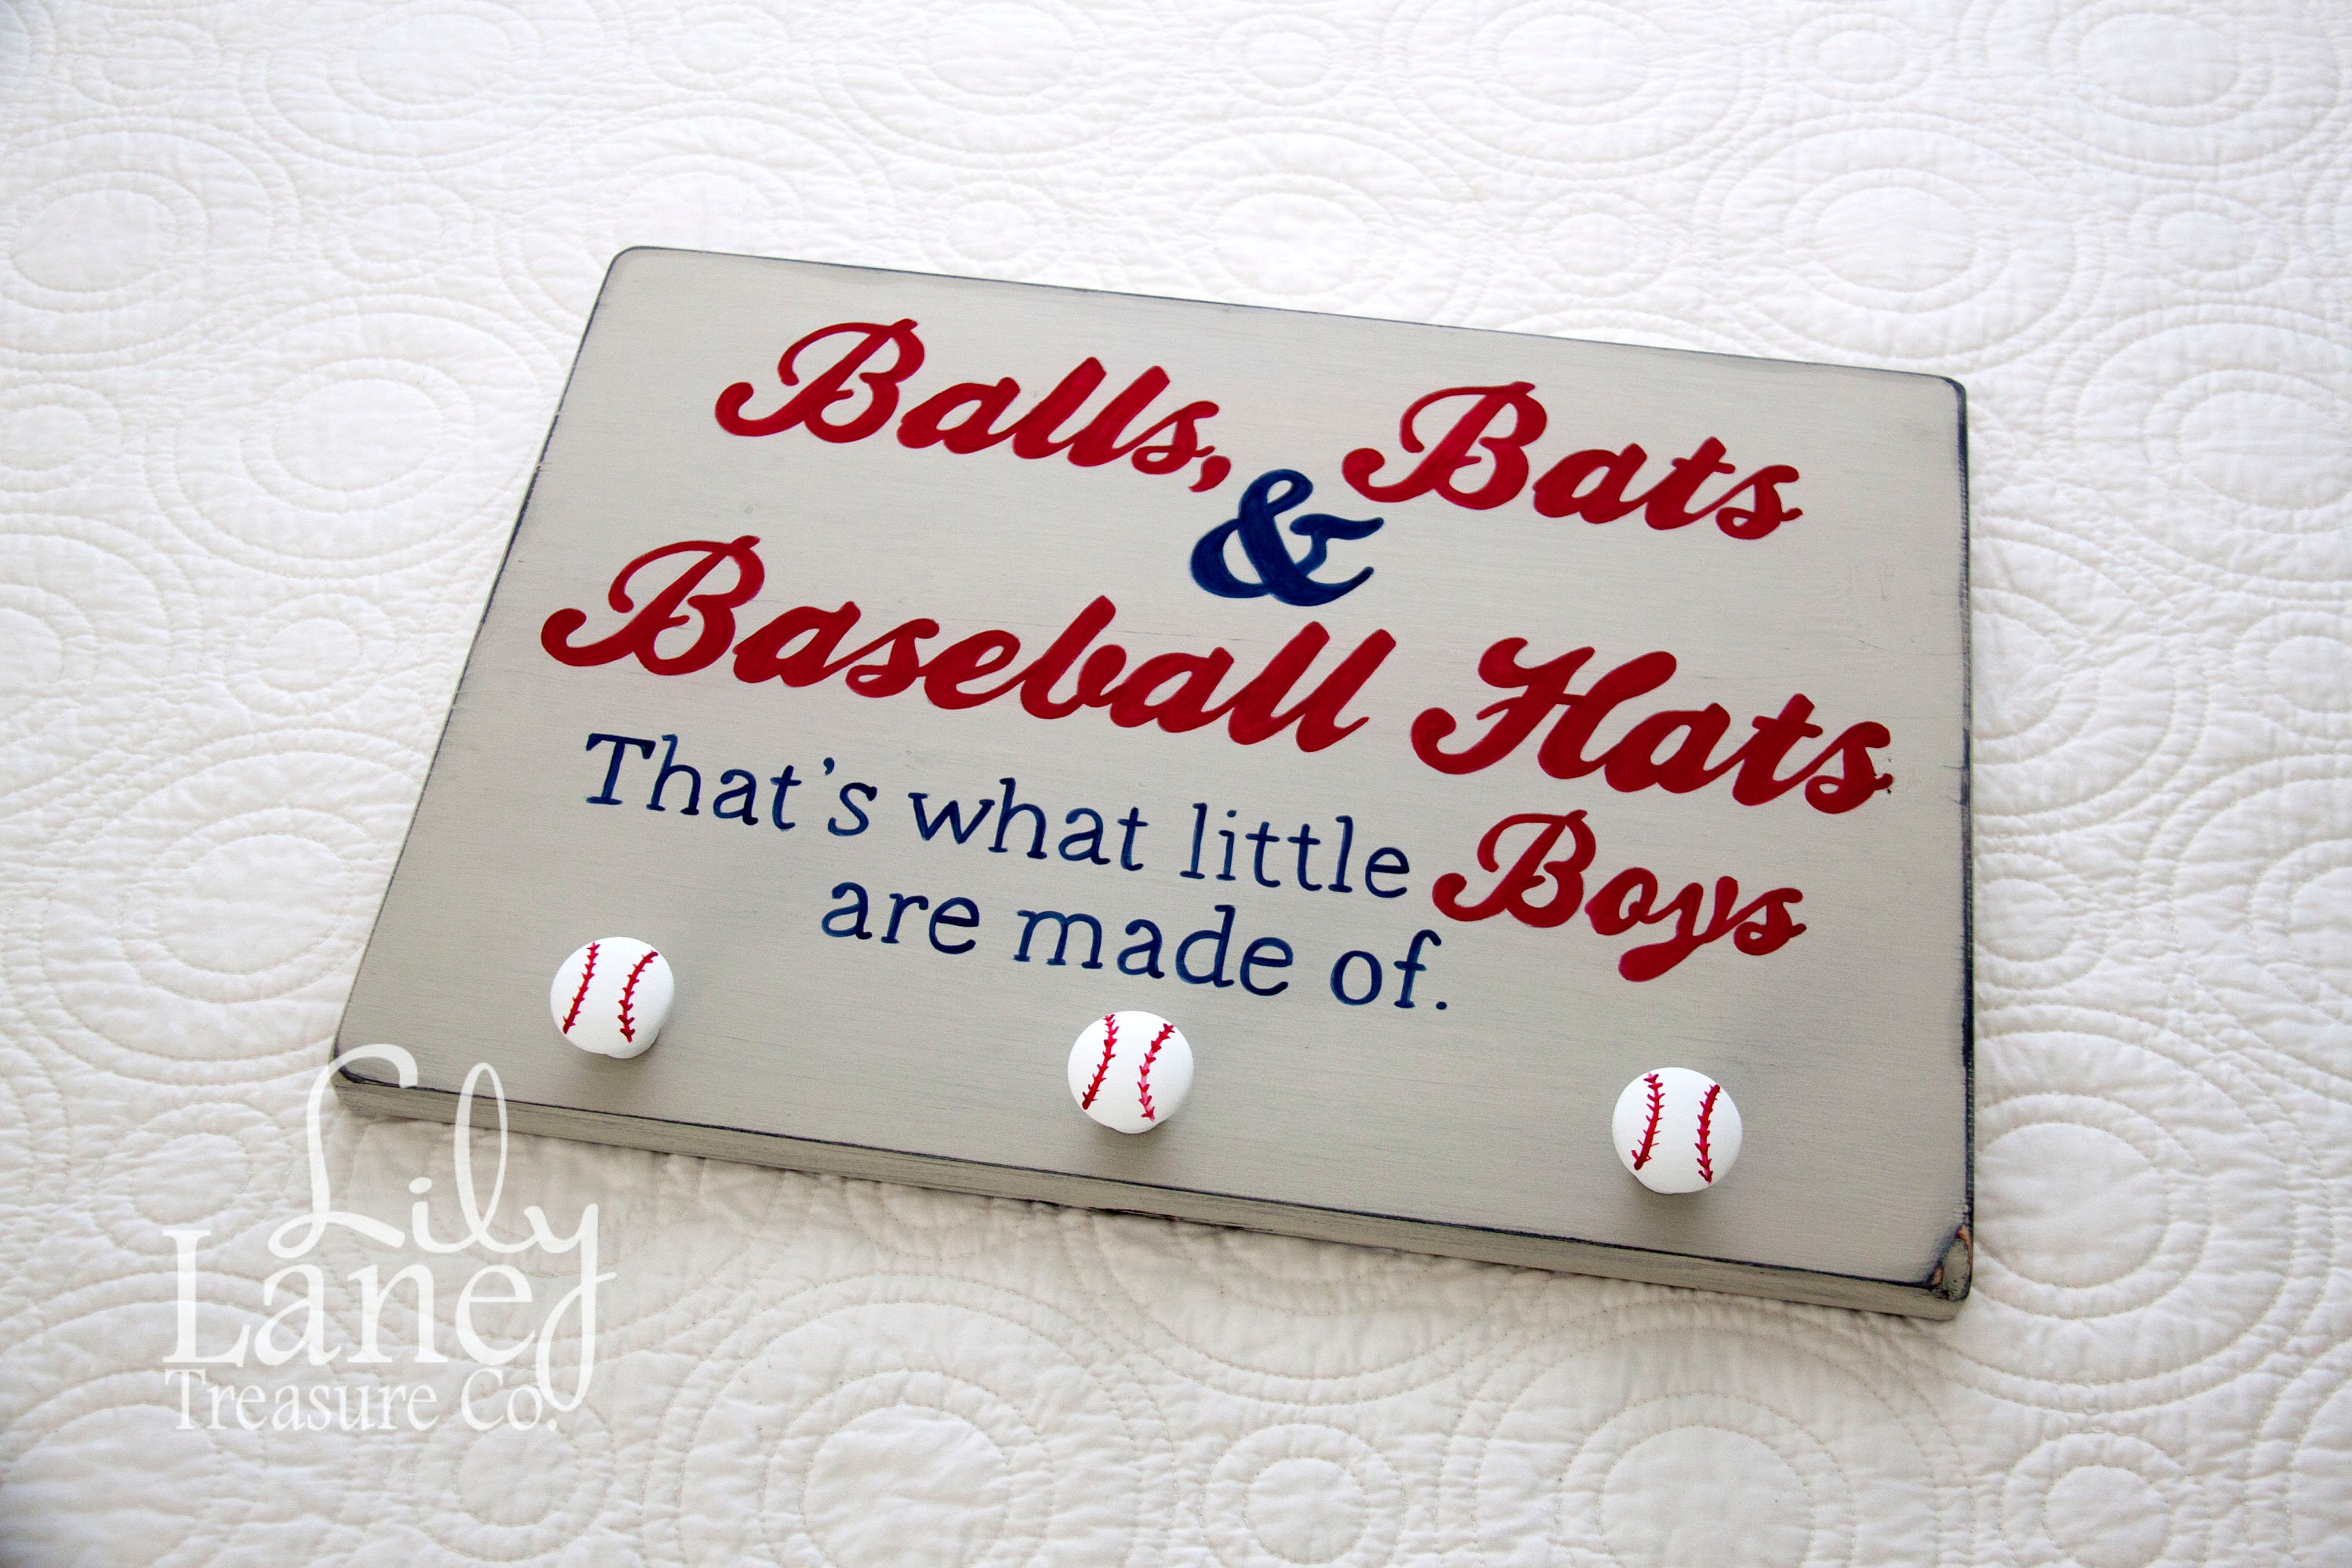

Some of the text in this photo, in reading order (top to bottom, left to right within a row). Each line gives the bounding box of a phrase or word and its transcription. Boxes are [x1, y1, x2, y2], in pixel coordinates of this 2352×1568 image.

[713, 317, 1804, 541] Balls, Bats
[1189, 467, 1385, 608] &
[539, 535, 1894, 815] Baseball Hats
[585, 732, 1807, 983] That's what little Boys
[820, 880, 1448, 1011] are made of.
